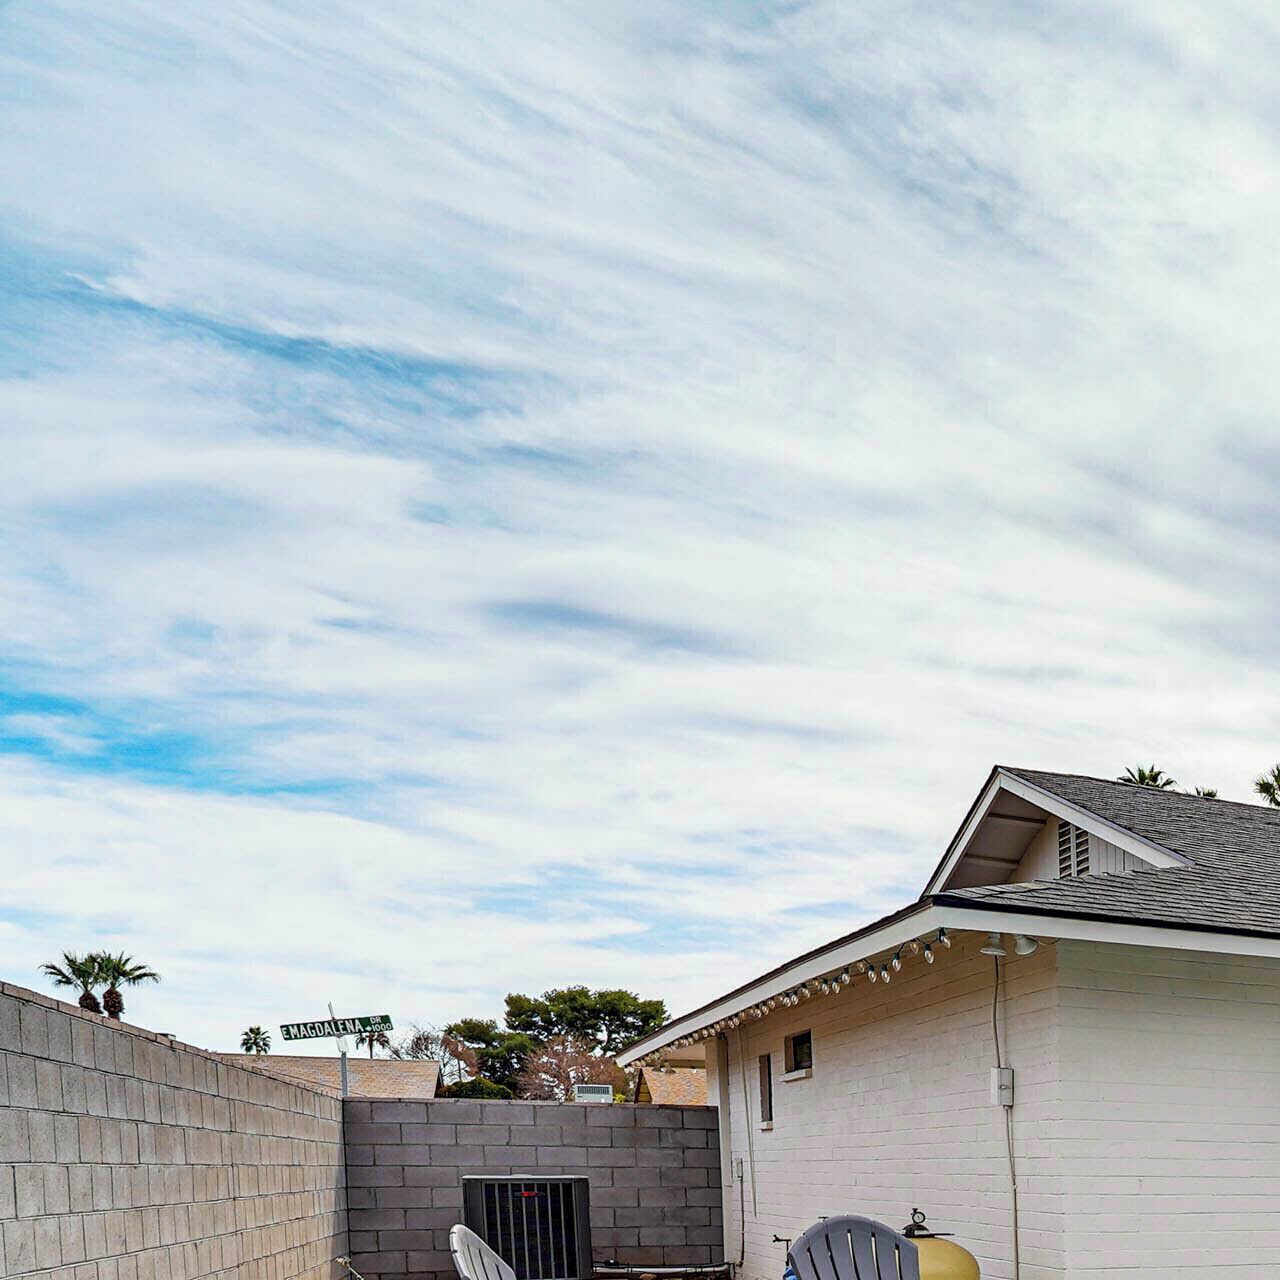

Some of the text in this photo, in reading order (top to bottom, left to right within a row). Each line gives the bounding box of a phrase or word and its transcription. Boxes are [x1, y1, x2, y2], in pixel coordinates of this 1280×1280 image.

[369, 1016, 382, 1024] DR
[281, 1019, 364, 1039] E MAGDALENA
[371, 1022, 392, 1033] 1000
